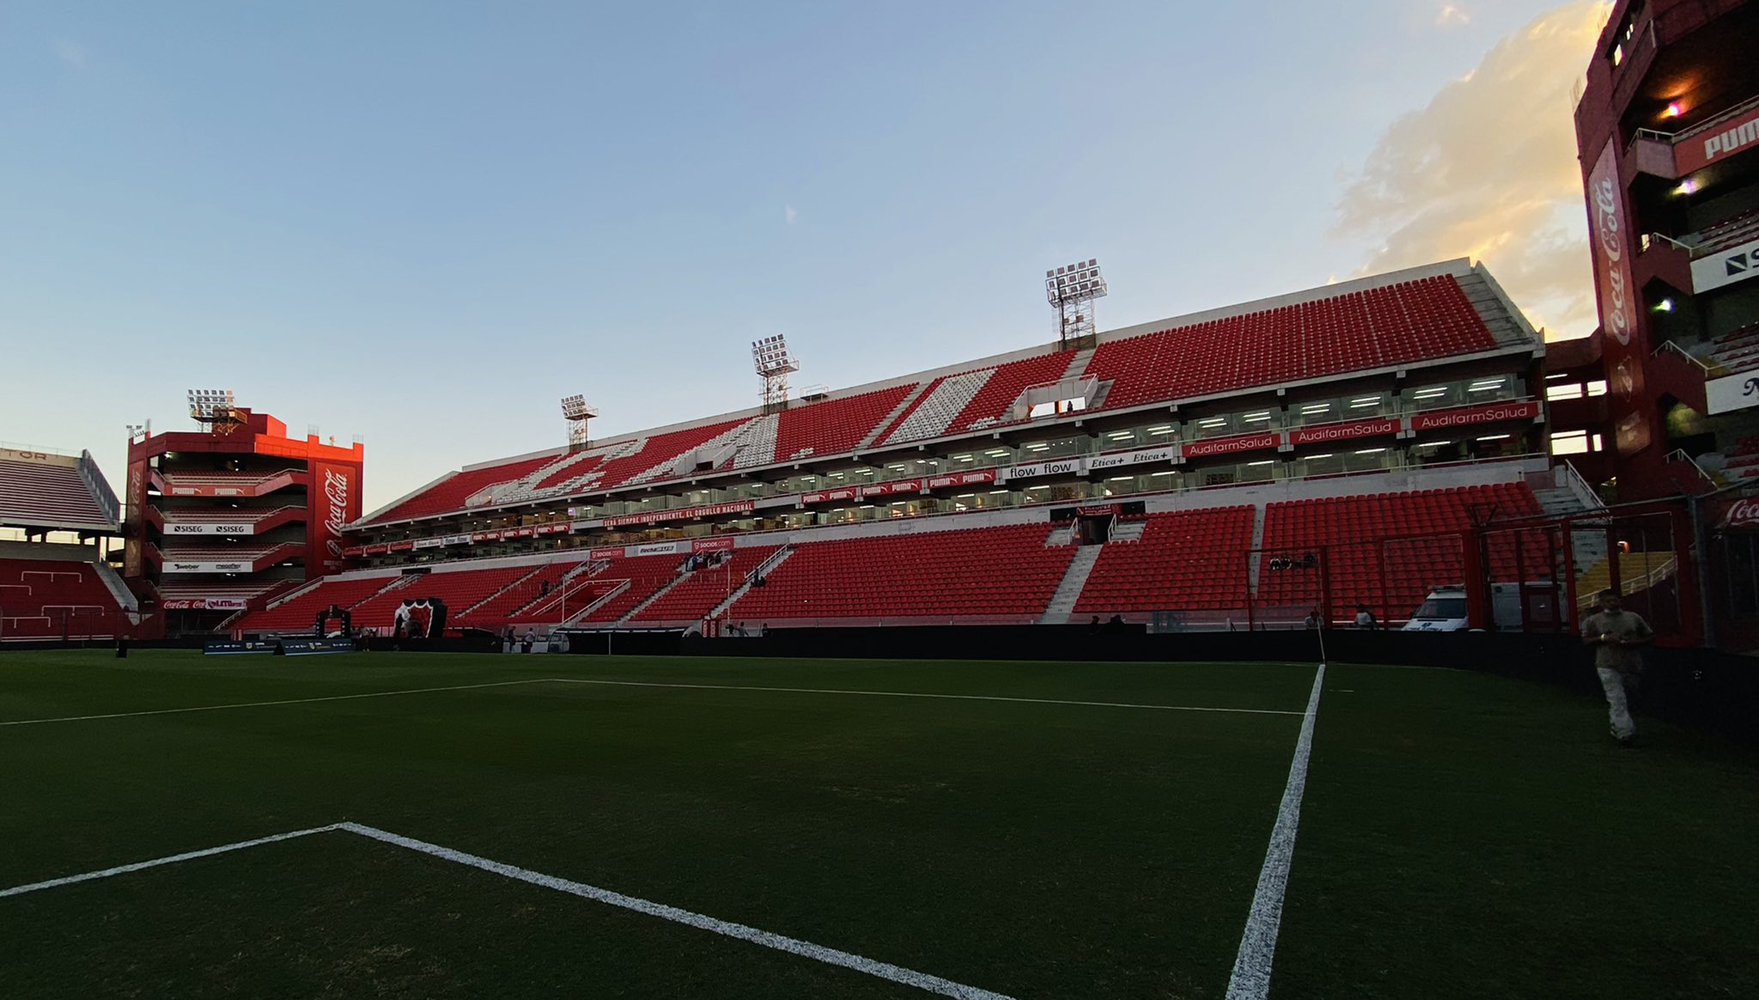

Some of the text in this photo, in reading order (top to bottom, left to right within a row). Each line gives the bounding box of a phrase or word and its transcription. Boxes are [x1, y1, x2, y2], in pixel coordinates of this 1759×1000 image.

[1422, 406, 1528, 428] AudifarmSalud
[1298, 422, 1392, 442] AudifarmSalud
[1189, 437, 1272, 456] AudifarmSalud
[1010, 462, 1071, 478] flow flow
[930, 473, 985, 488] PUMA PUMA
[863, 482, 911, 496] PUMA PUMA
[686, 510, 693, 518] EL
[695, 507, 720, 517] ORGULLO
[722, 503, 753, 514] NACIONAL
[181, 525, 245, 533] SISEG SISEG
[700, 539, 731, 549] socios.com
